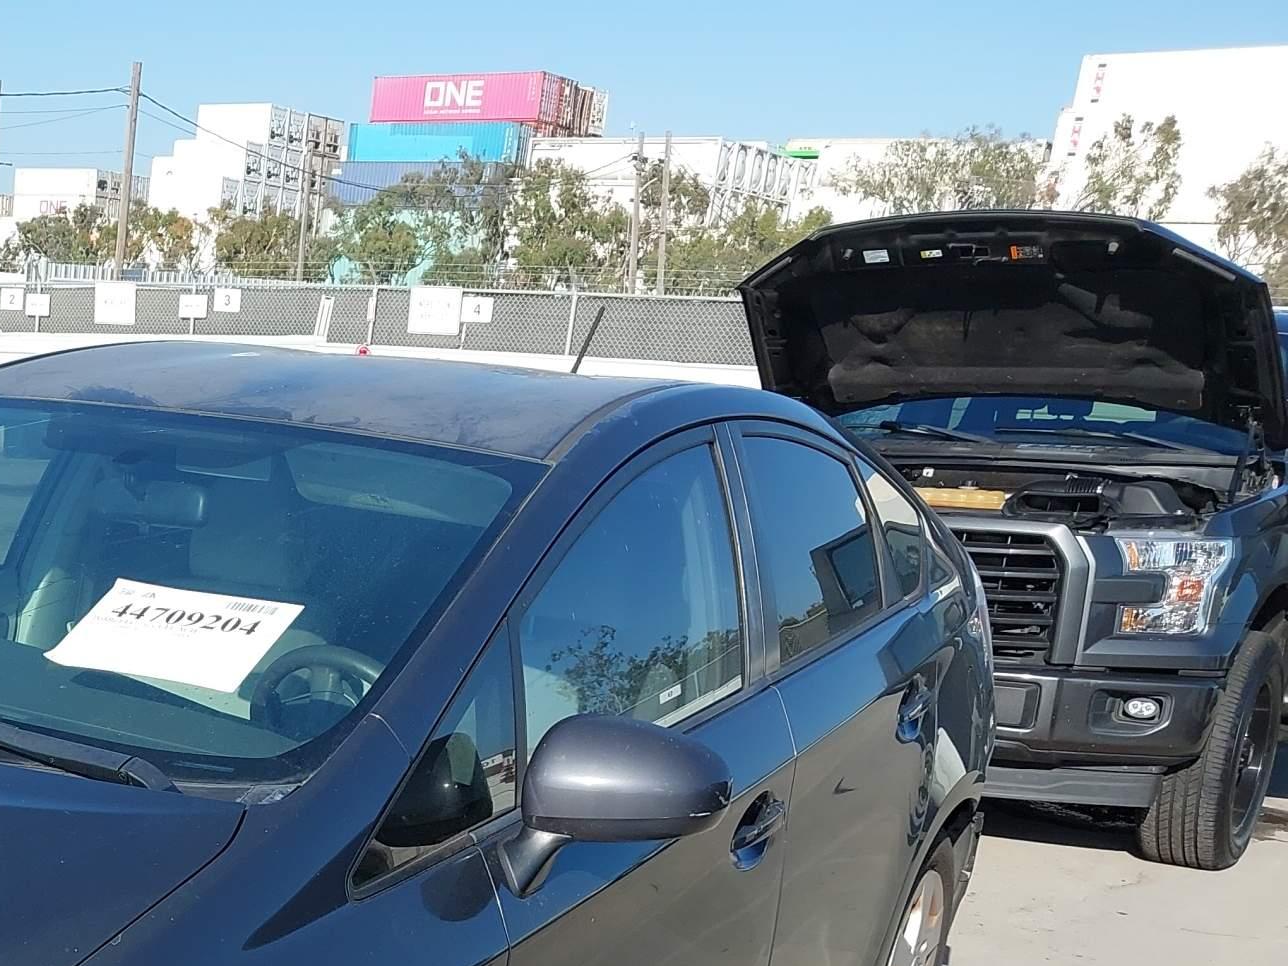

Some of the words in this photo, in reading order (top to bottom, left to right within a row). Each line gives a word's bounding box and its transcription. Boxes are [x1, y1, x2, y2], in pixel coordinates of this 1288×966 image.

[424, 80, 485, 106] ONE
[39, 200, 68, 214] ONE
[9, 294, 15, 305] 2
[223, 294, 231, 306] 3
[473, 303, 481, 316] 4
[112, 603, 261, 636] 44709204
